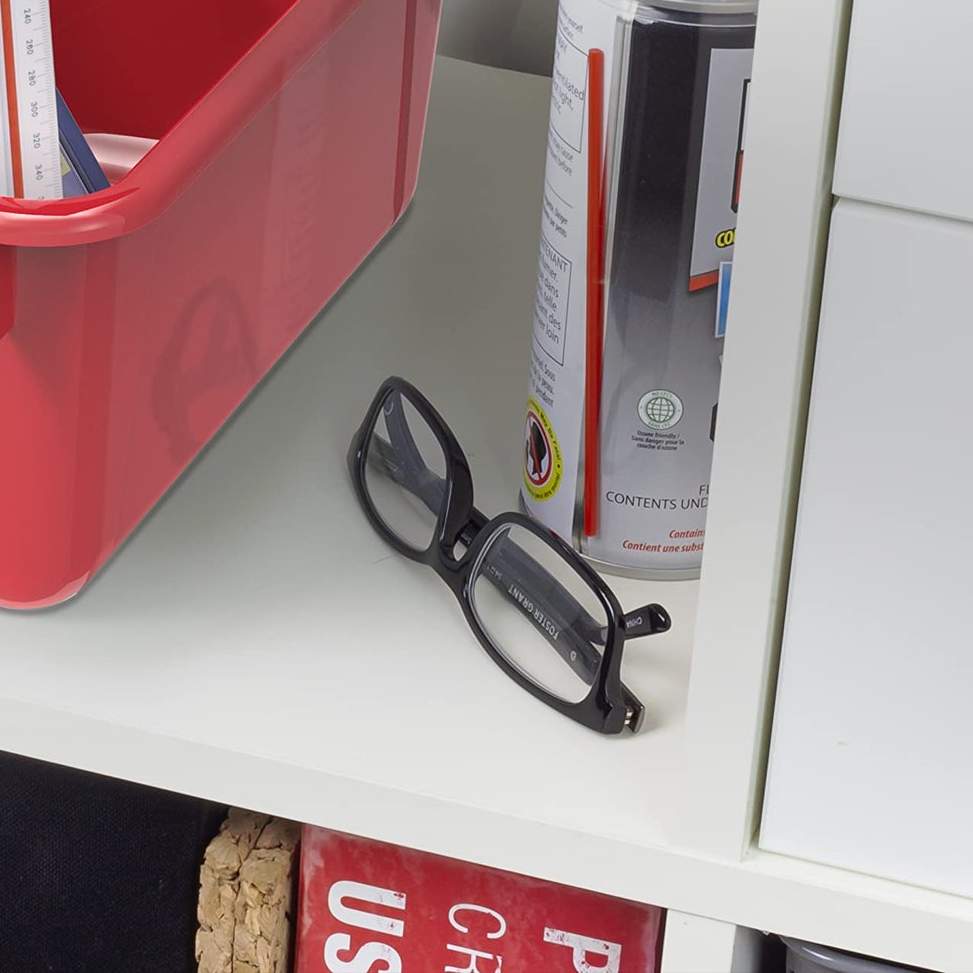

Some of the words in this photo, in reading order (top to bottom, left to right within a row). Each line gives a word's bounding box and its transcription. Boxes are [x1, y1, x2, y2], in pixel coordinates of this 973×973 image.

[24, 8, 32, 24] 240
[26, 40, 34, 55] 260
[28, 70, 36, 86] 280
[30, 102, 38, 118] 300
[33, 133, 41, 149] 320
[35, 164, 43, 181] 340
[606, 491, 676, 510] CONTENTS
[622, 540, 661, 552] Contient
[508, 584, 534, 613] GRANT
[534, 609, 560, 640] FOSTER
